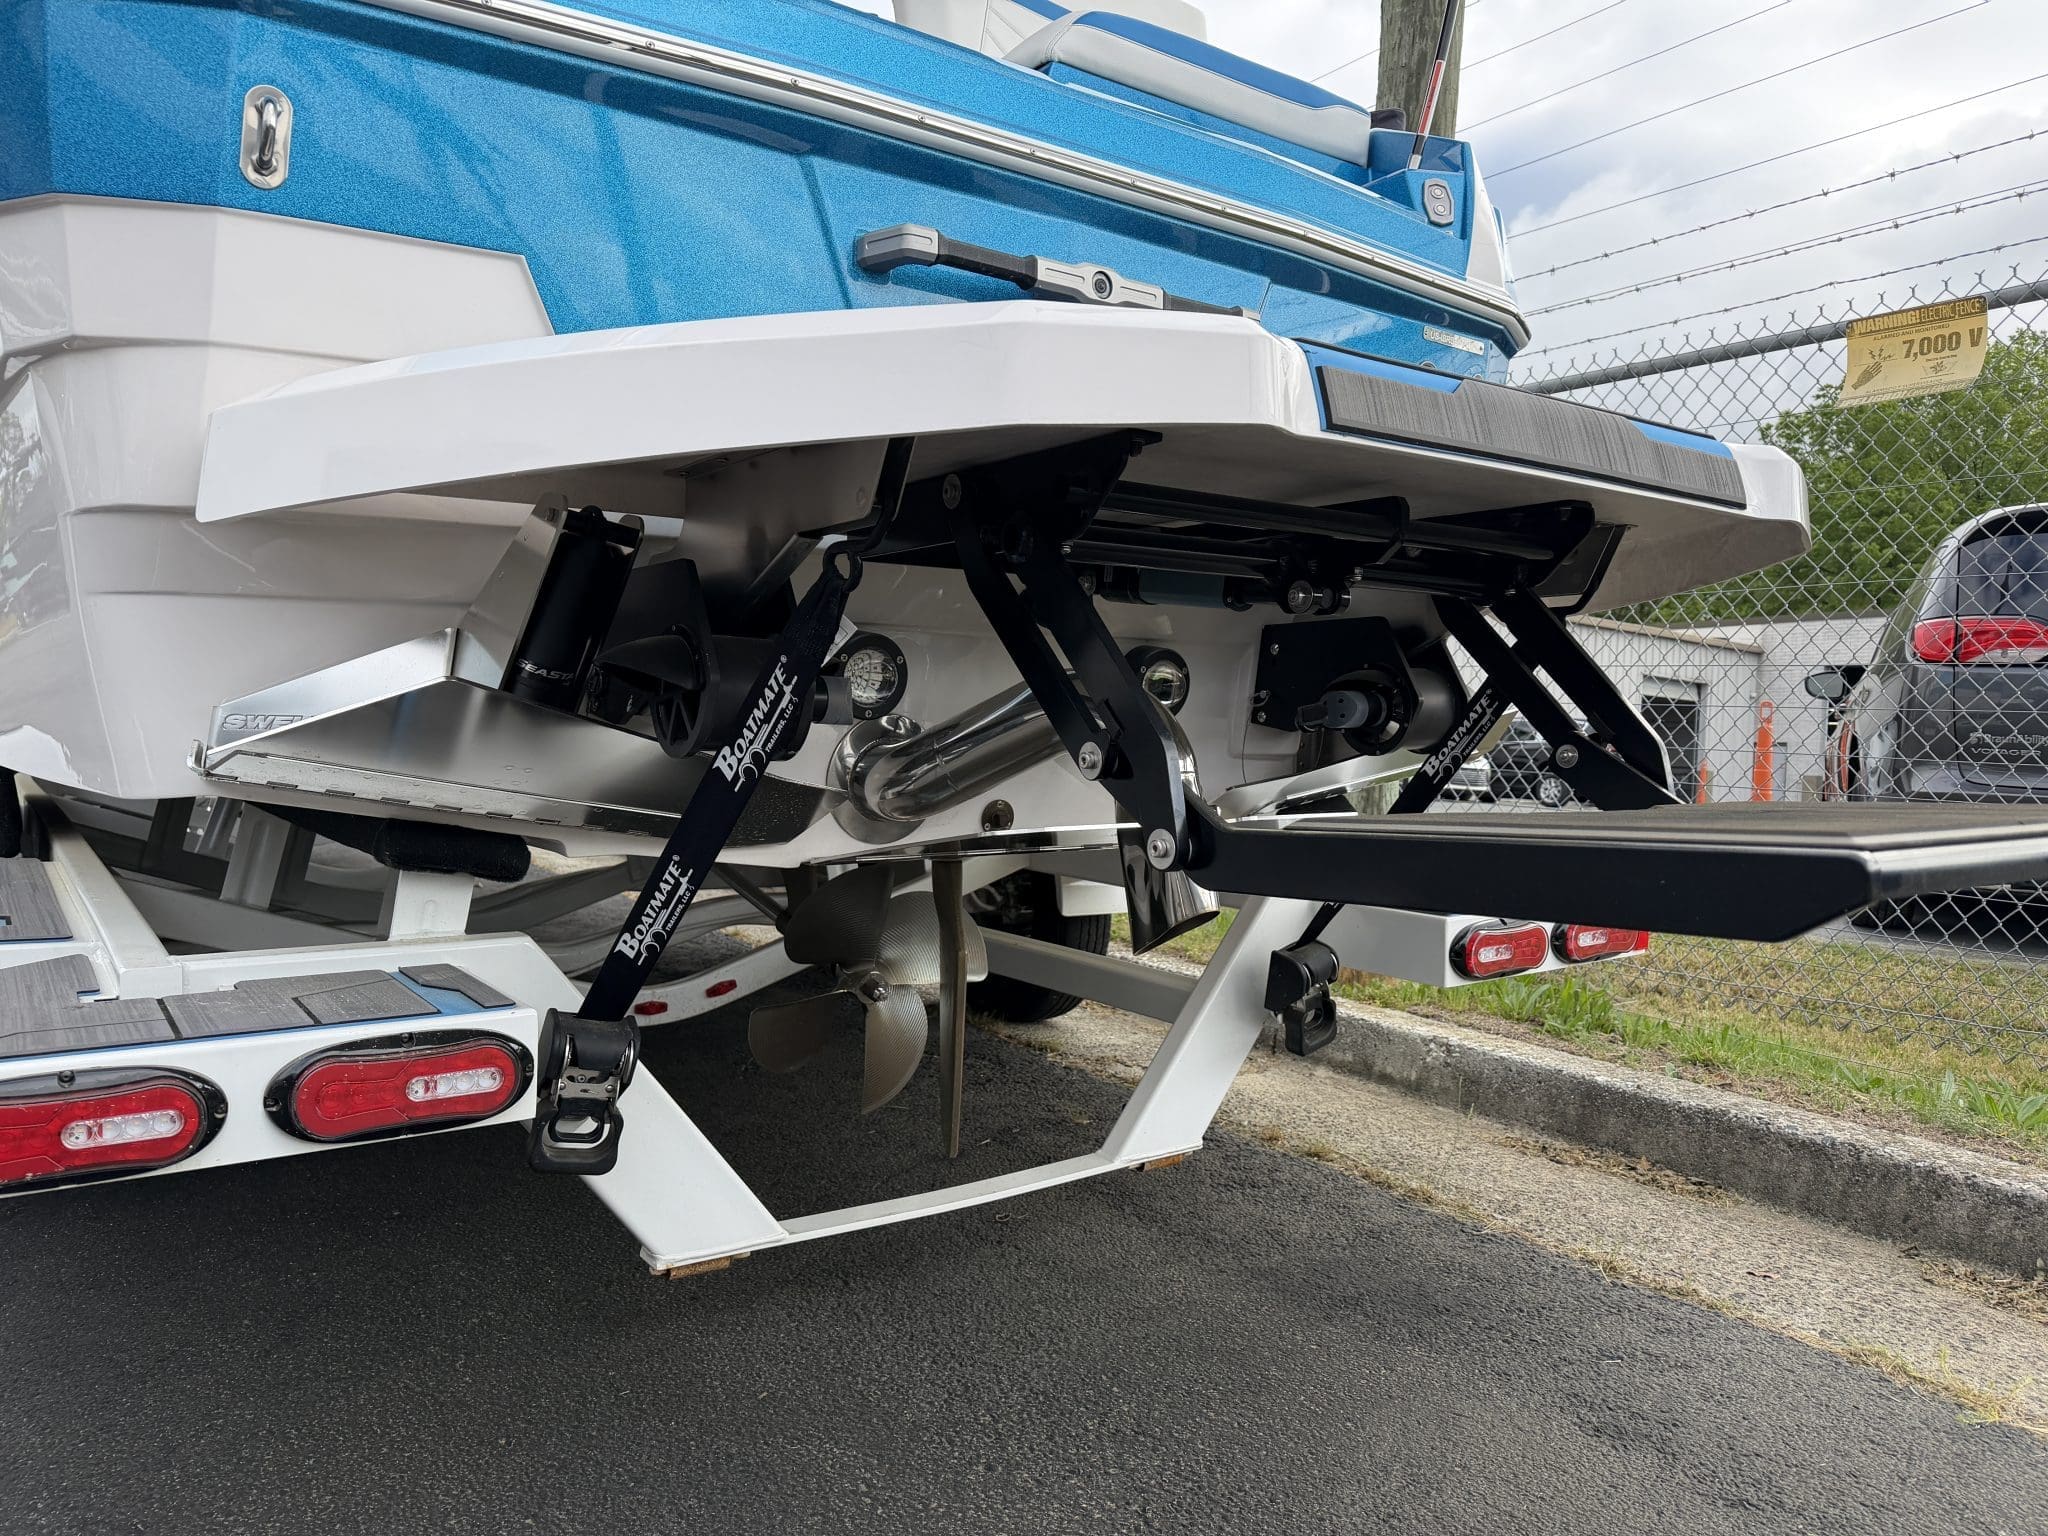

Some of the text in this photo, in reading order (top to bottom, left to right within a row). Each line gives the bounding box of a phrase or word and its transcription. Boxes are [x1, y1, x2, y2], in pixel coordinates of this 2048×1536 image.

[1853, 298, 1980, 334] WARNING! ELECTRIC FENCE
[1914, 323, 1950, 333] MONITORED
[1902, 327, 1983, 361] 7,000 V
[783, 703, 794, 719] LLC
[682, 891, 691, 906] LLC
